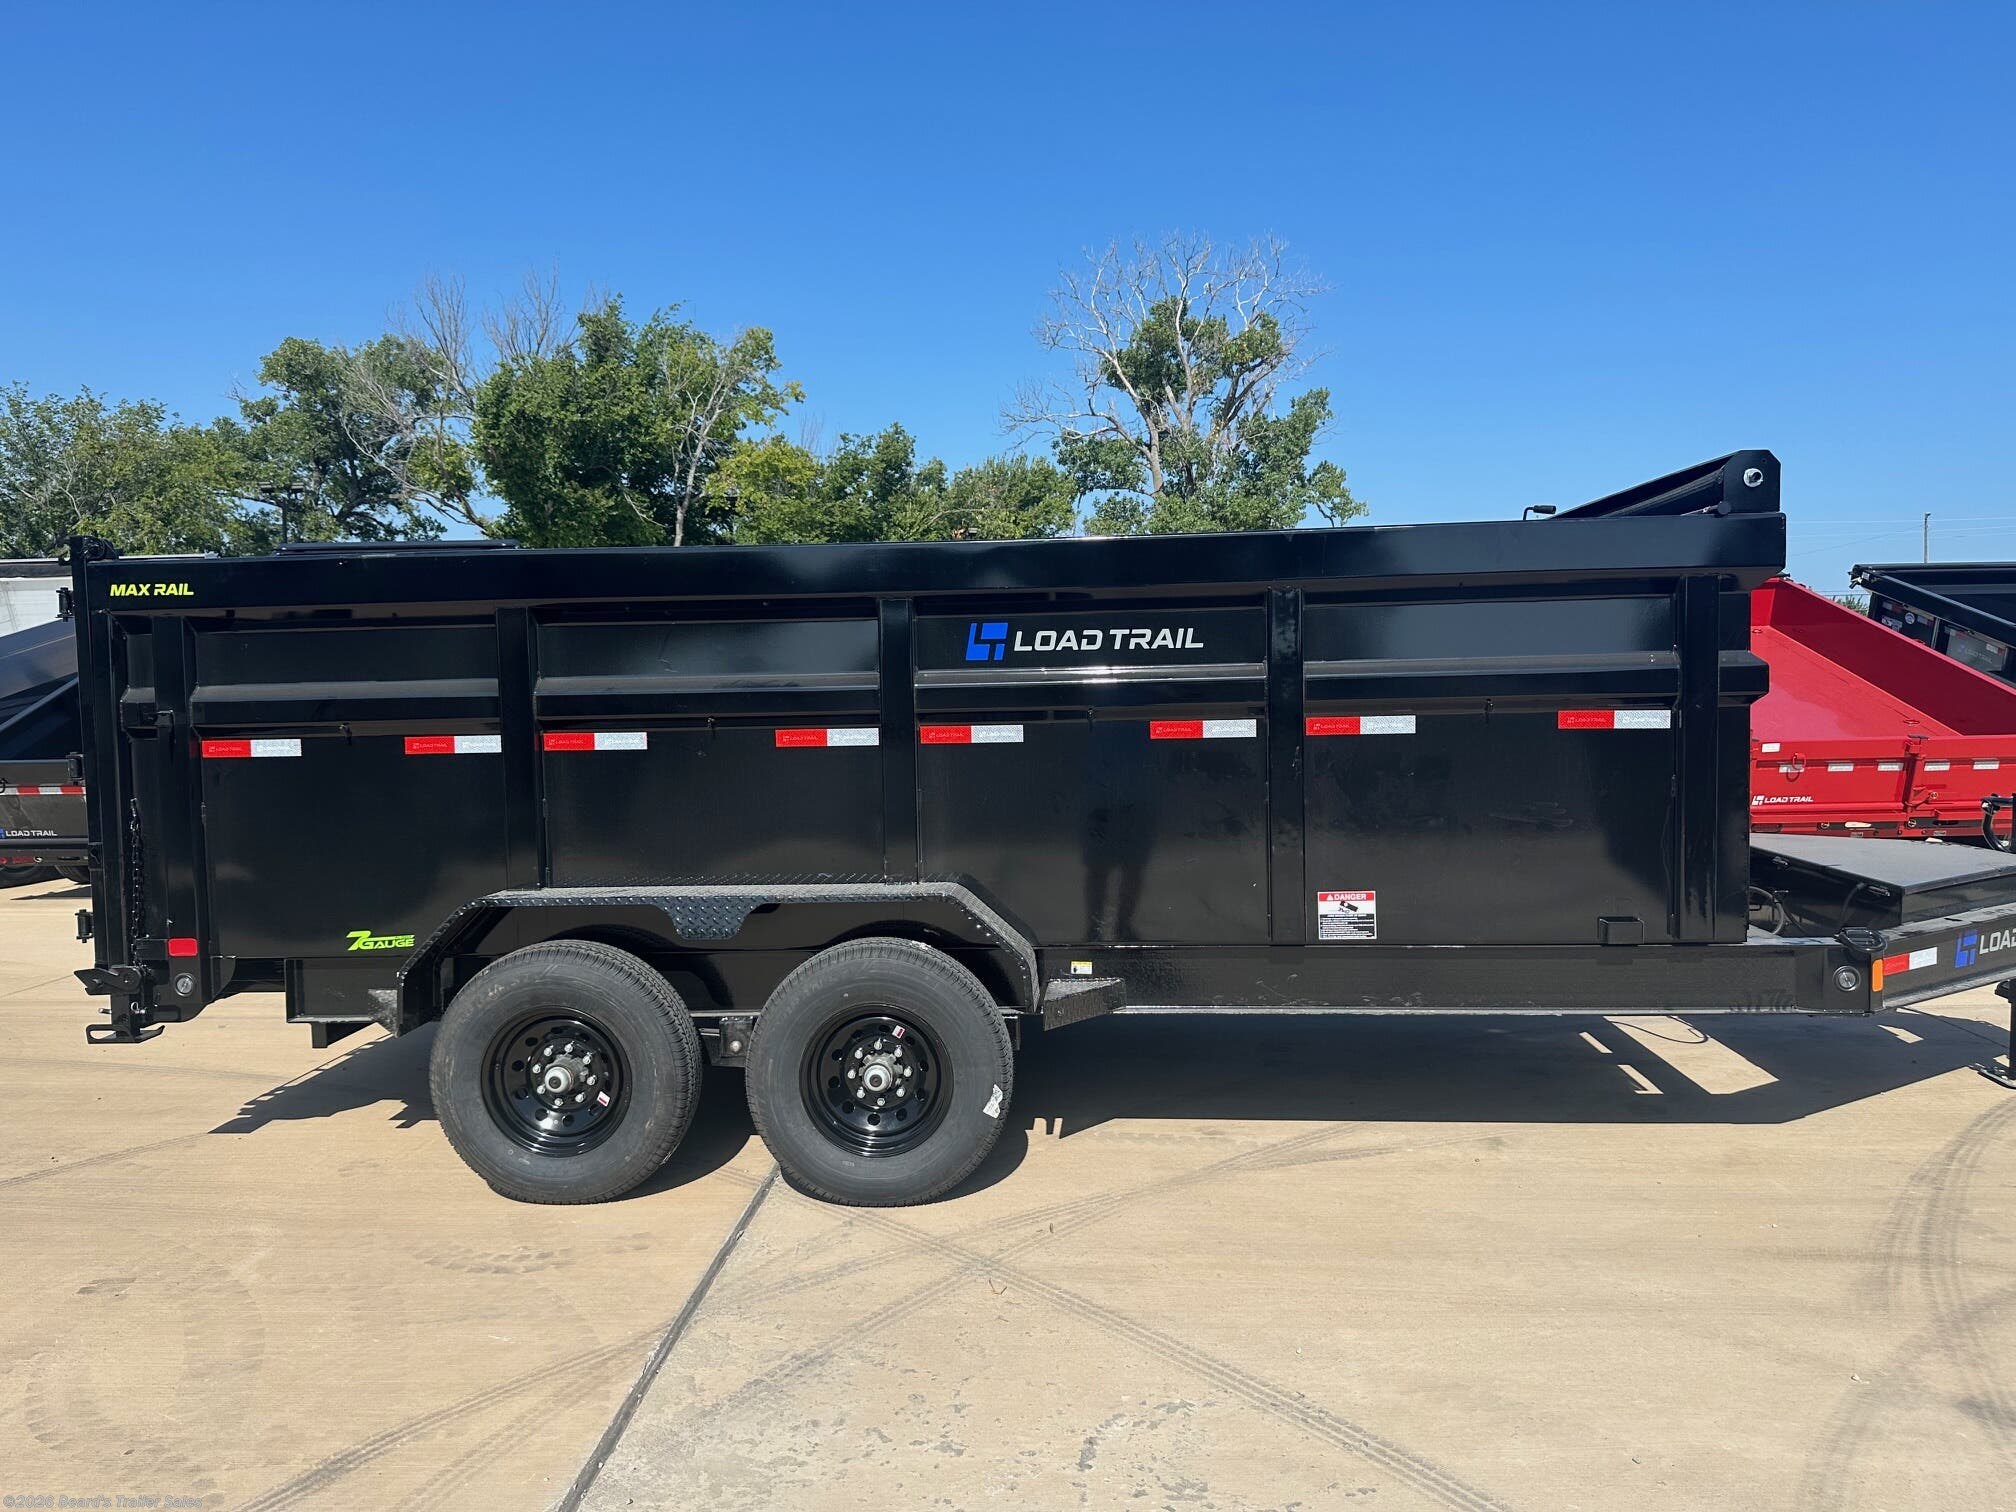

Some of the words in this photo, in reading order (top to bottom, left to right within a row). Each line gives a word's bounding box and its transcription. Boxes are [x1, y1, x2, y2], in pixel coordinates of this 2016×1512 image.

[110, 583, 151, 597] MAX
[153, 583, 195, 596] RAIL
[1014, 629, 1103, 652] LOAD
[1109, 627, 1204, 650] TRAIL
[1789, 795, 1814, 803] TRAIL
[30, 829, 58, 837] TRAIL
[1333, 893, 1367, 901] DANGER
[359, 938, 415, 950] GAUGE
